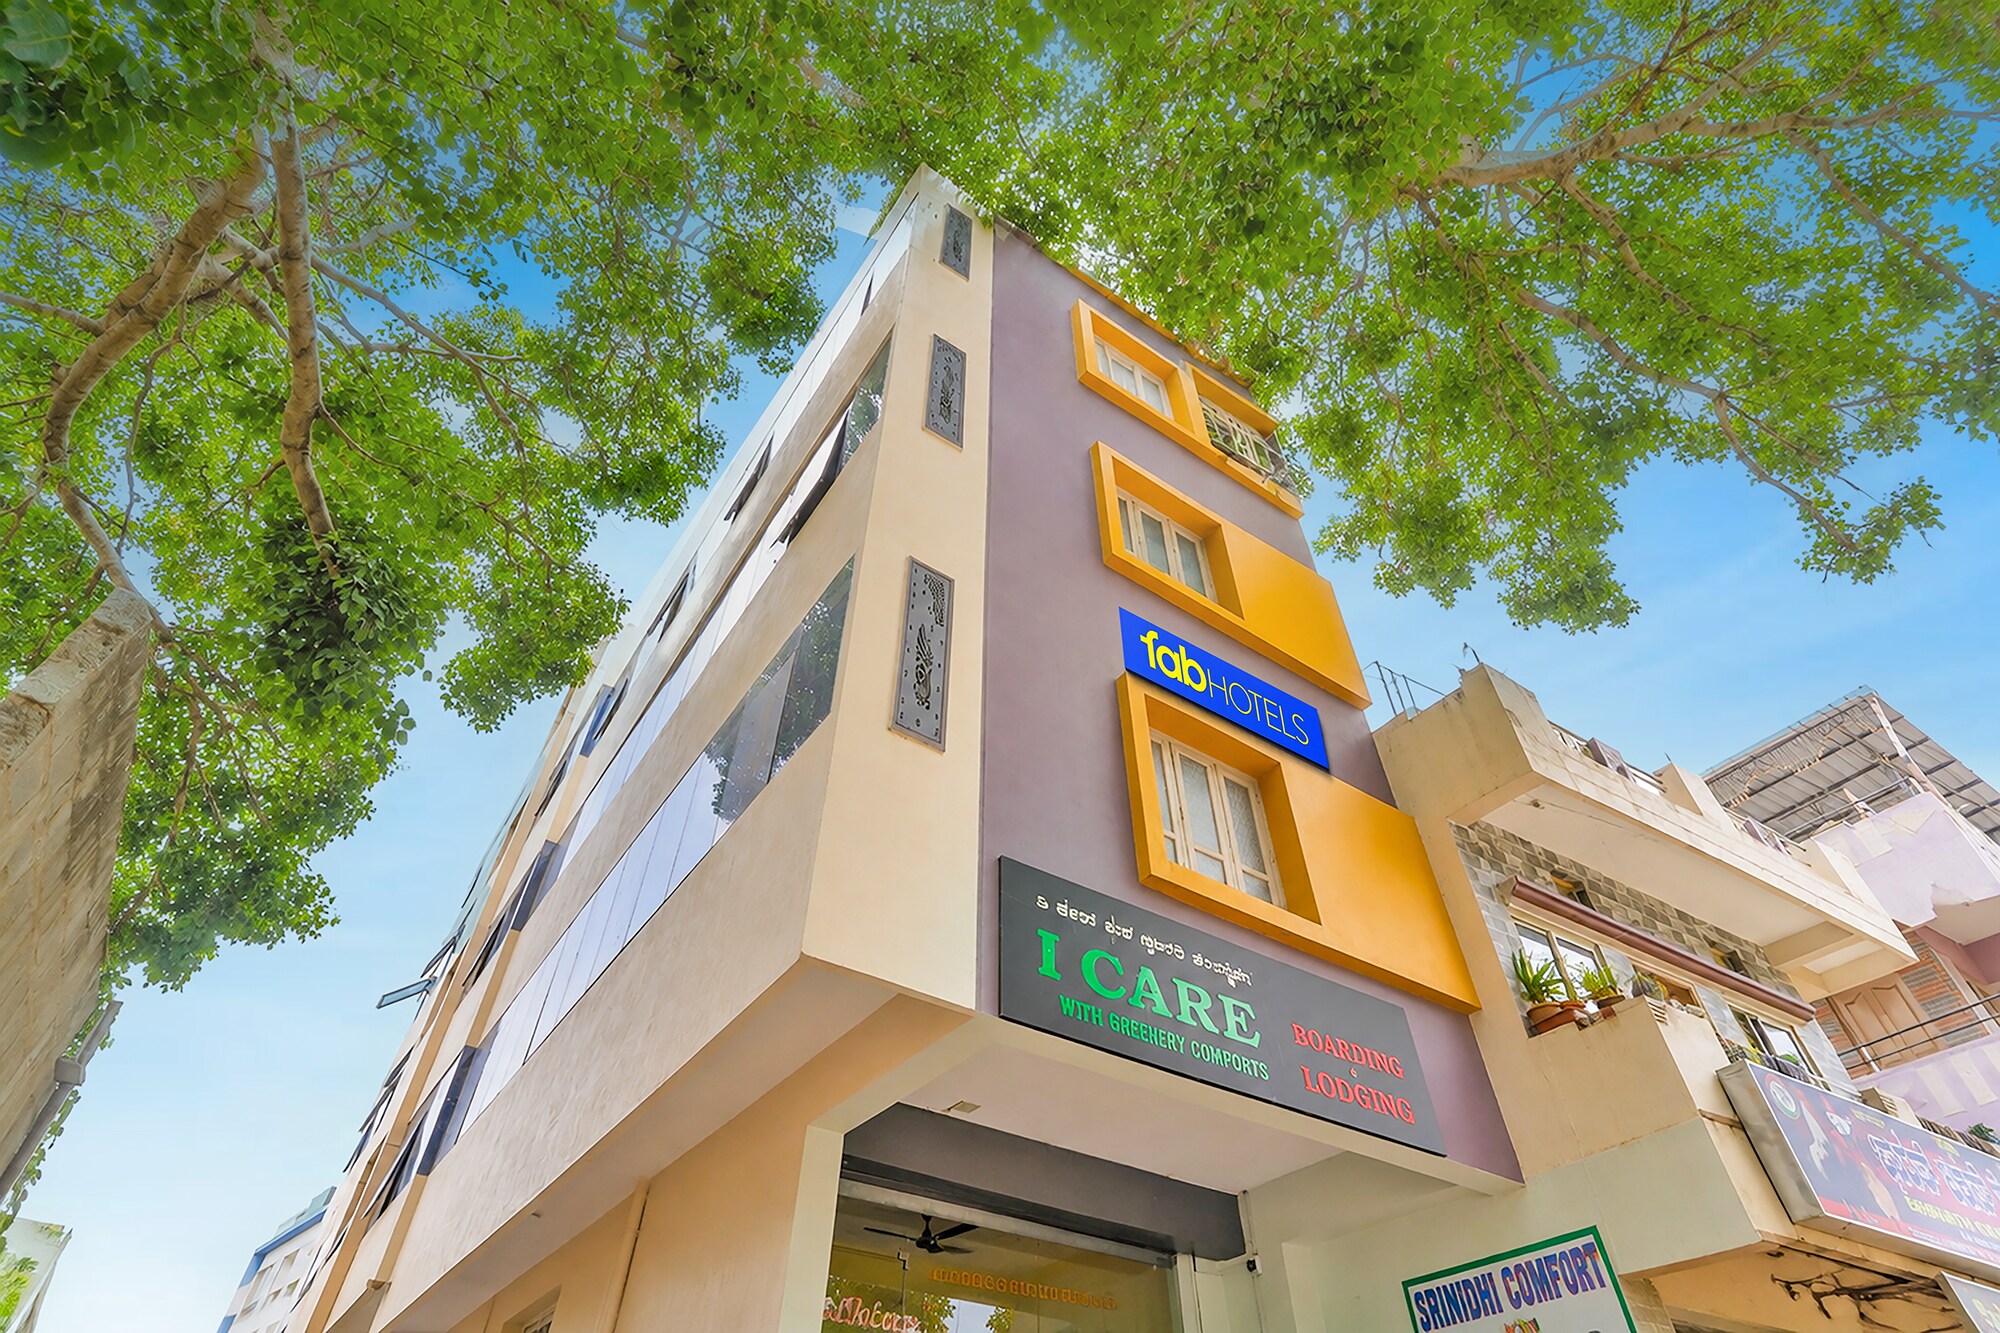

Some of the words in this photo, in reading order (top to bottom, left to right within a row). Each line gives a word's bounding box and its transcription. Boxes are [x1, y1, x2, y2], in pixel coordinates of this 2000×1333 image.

[1037, 928, 1061, 980] I
[1081, 949, 1260, 1048] CARE
[1059, 994, 1104, 1027] WITH
[1291, 1023, 1404, 1079] BOARDING
[1300, 1065, 1415, 1124] LODGING
[1414, 1272, 1504, 1332] SRINIDHI
[1501, 1241, 1606, 1310] COMFORT
